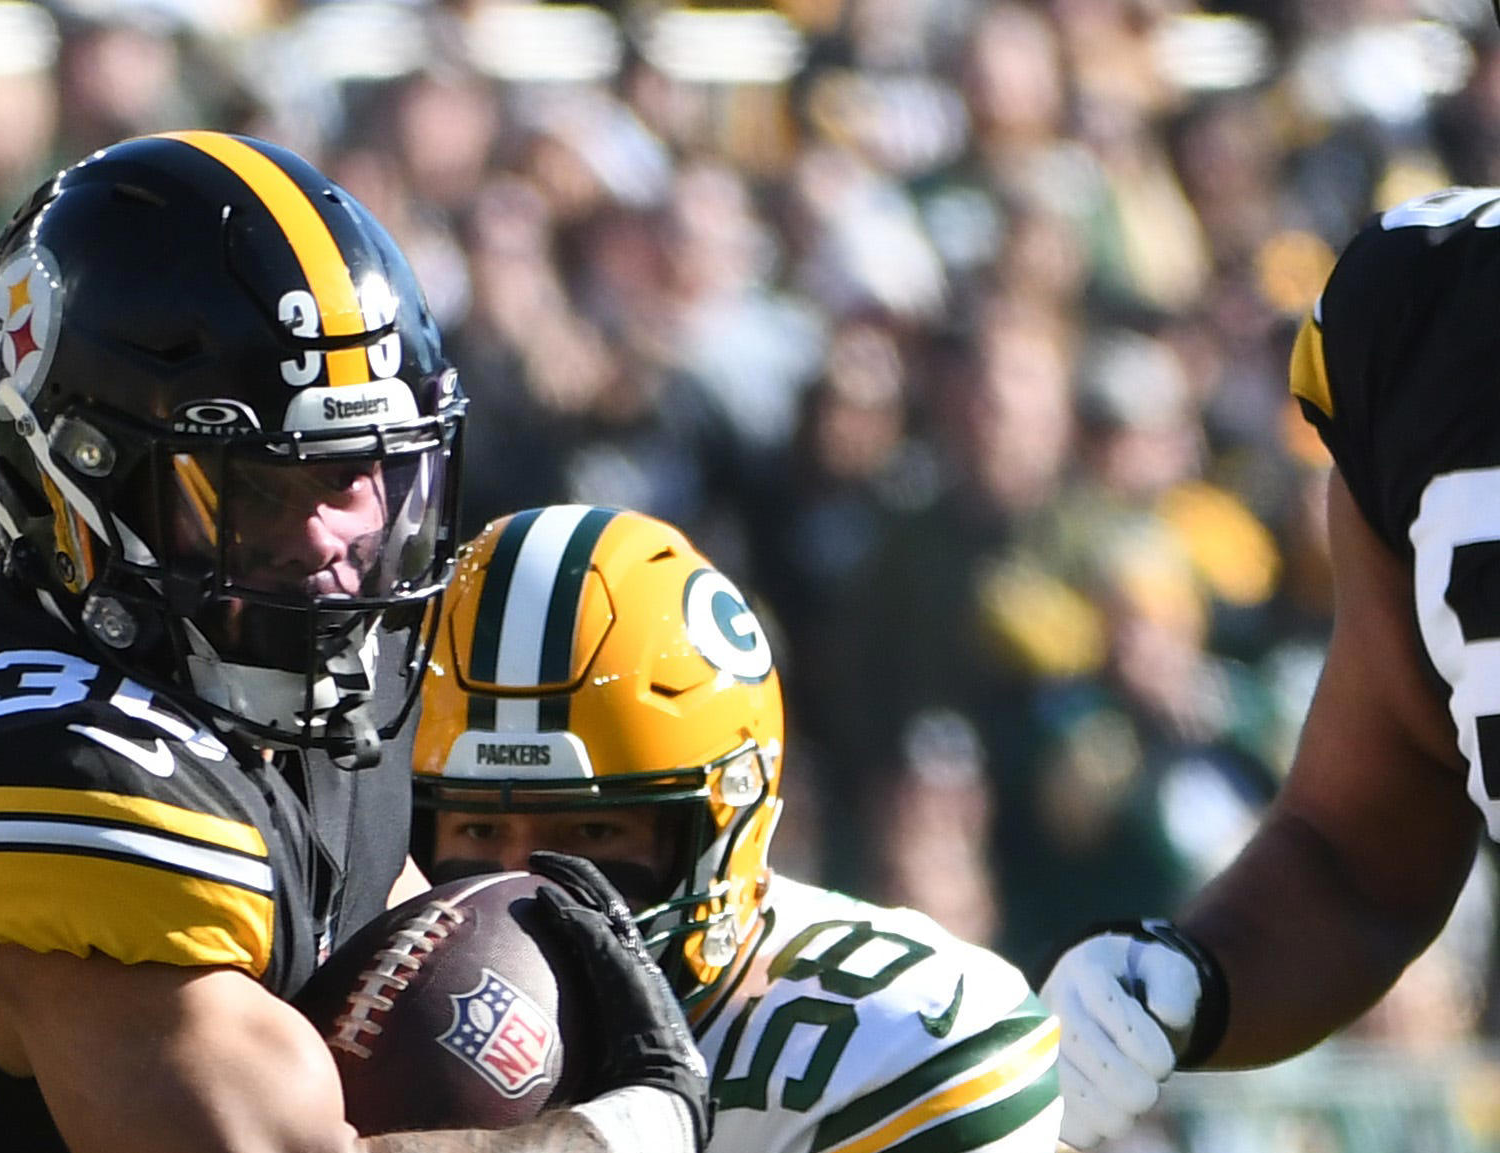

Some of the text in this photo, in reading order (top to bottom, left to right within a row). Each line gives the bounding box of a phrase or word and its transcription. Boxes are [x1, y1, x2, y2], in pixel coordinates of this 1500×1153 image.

[322, 396, 389, 421] Steelers
[683, 567, 772, 684] G
[476, 743, 551, 766] PACKERS
[483, 1013, 547, 1086] NFL
[709, 919, 937, 1113] 58
